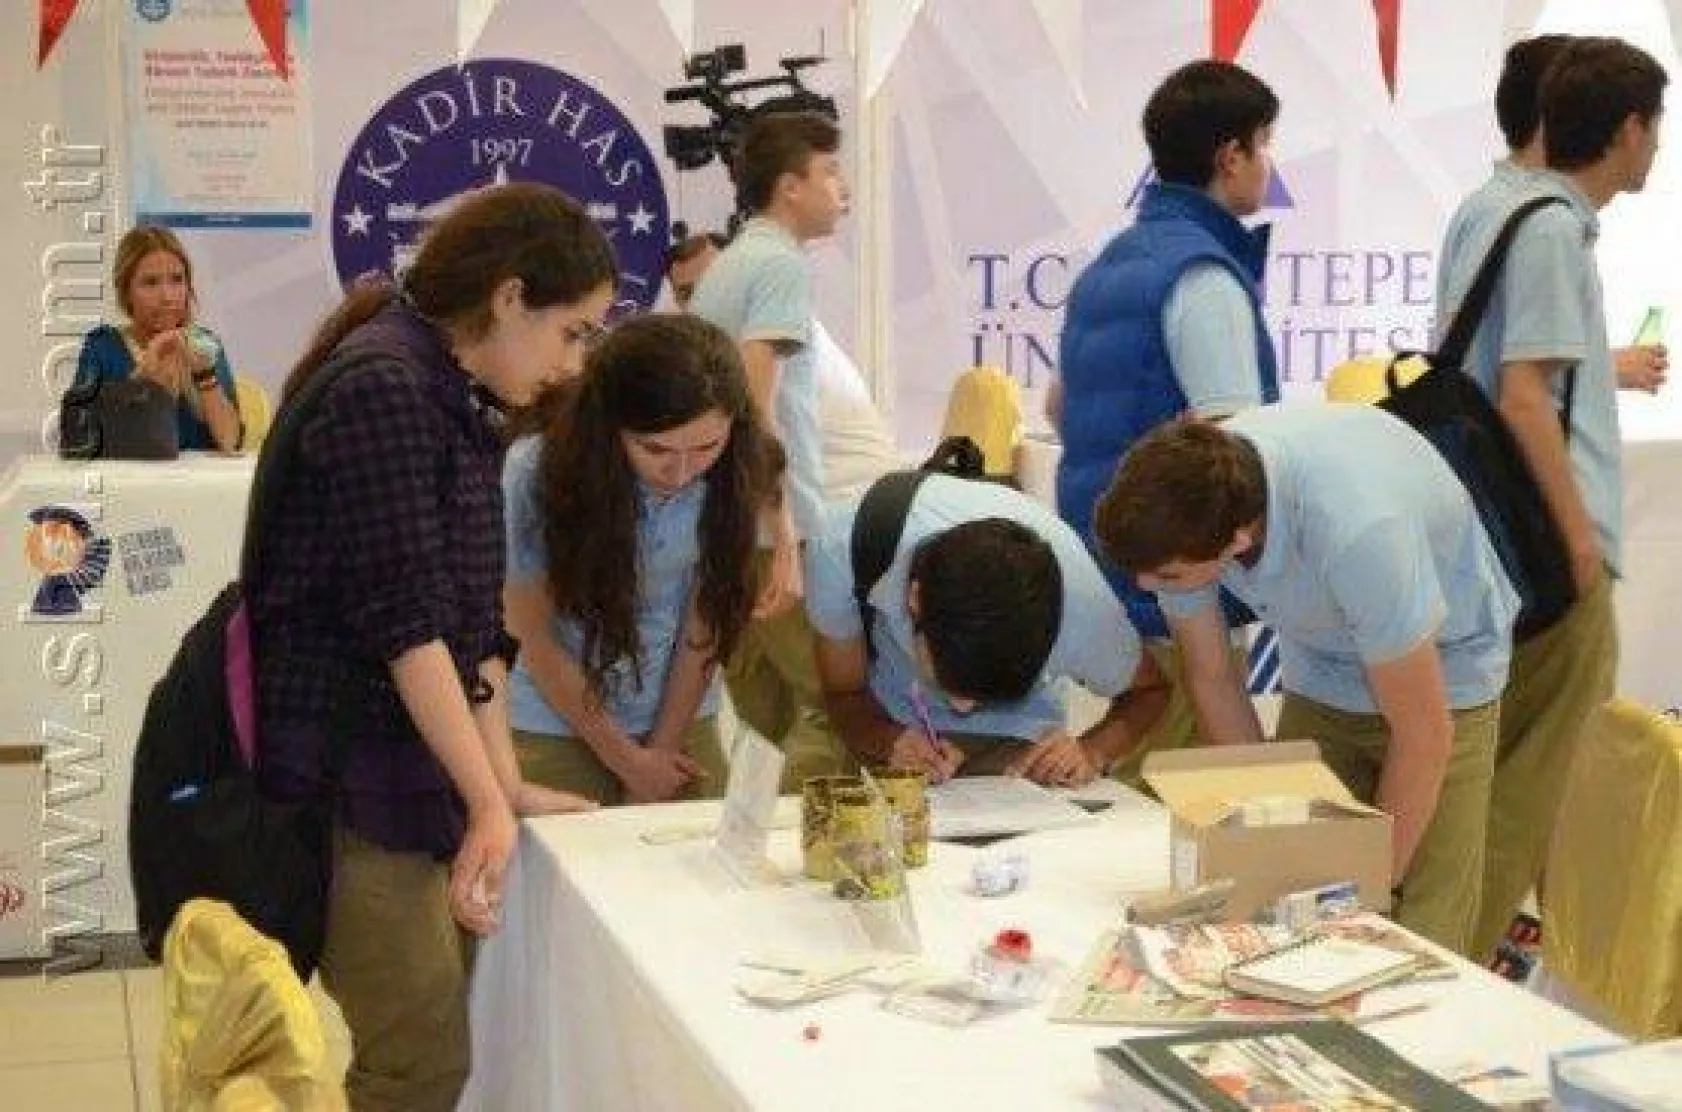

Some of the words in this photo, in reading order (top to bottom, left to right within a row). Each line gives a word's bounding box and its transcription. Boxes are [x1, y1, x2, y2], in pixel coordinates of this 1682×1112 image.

[355, 69, 526, 188] KADİR
[548, 90, 644, 187] HAS
[470, 137, 534, 166] 1997
[1272, 252, 1433, 307] TEPE
